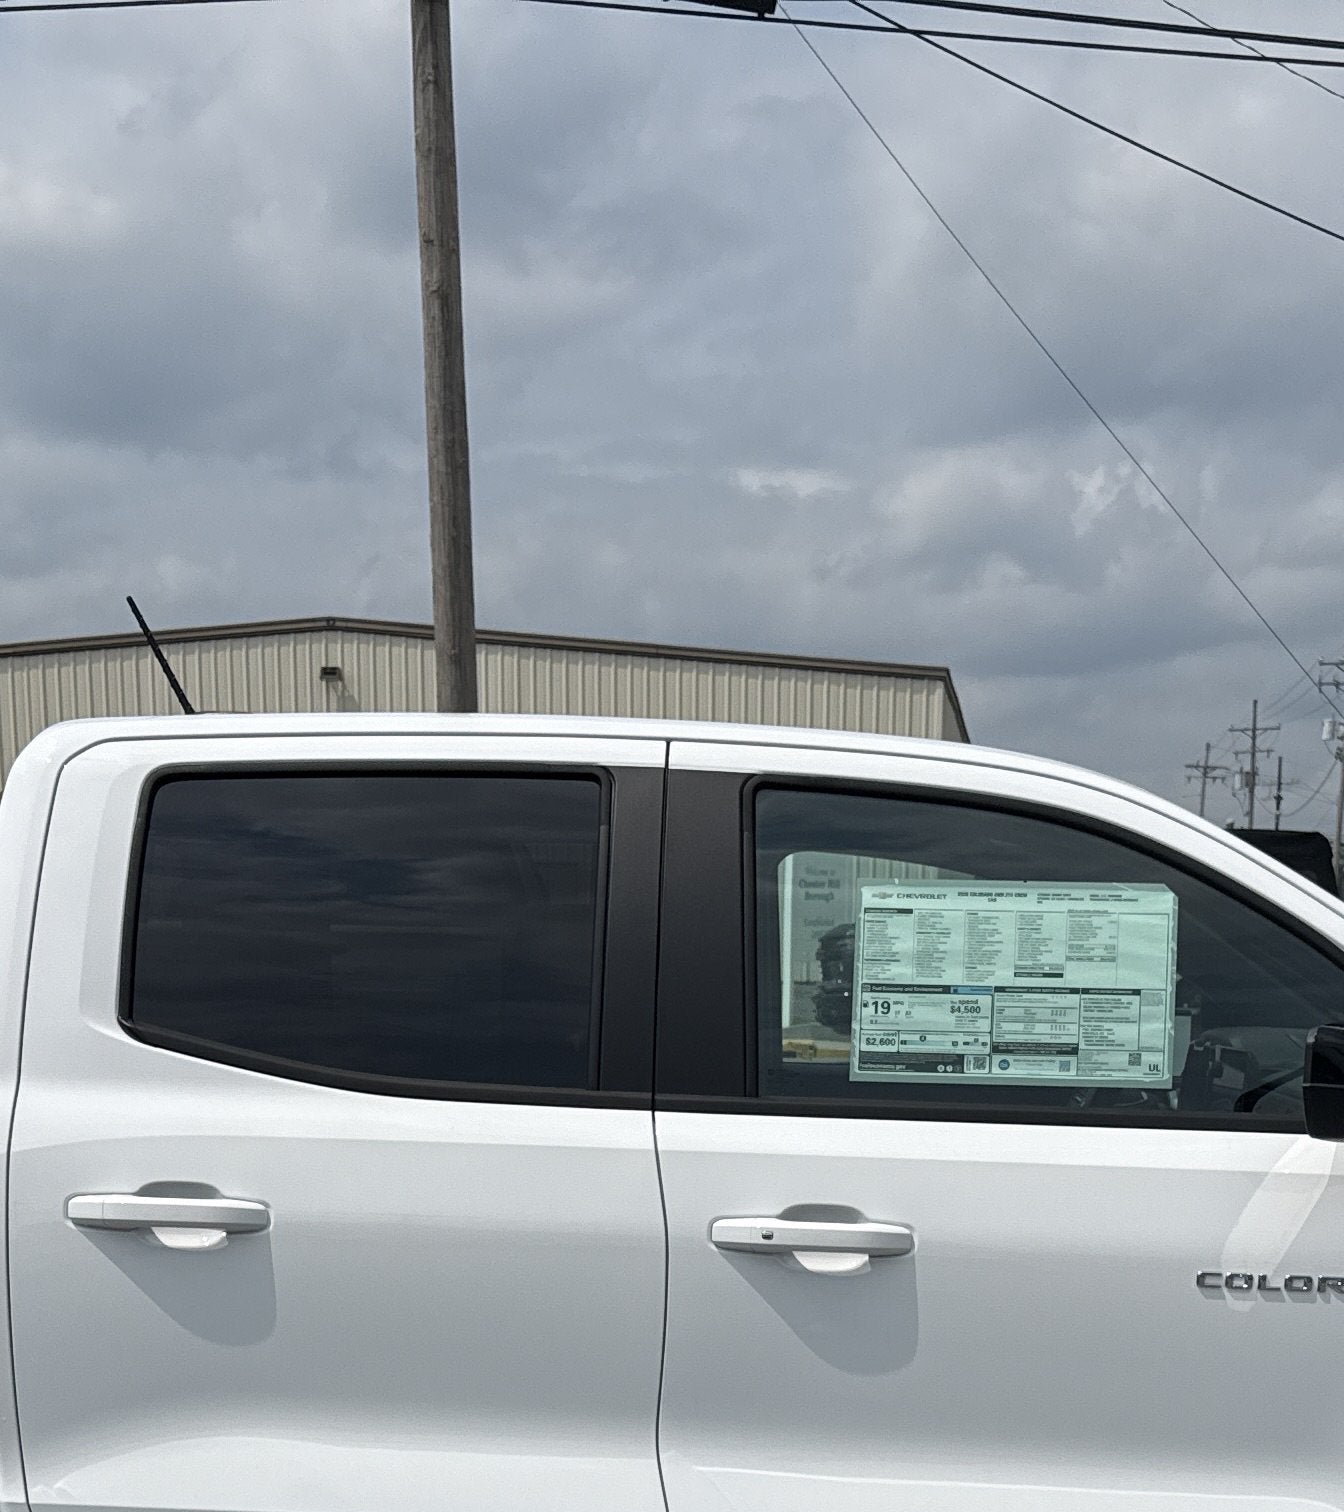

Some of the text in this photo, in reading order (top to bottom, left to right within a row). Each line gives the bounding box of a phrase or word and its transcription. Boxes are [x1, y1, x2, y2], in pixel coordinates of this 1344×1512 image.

[896, 892, 948, 900] CHEVROLET
[871, 1000, 891, 1014] 19
[949, 1005, 981, 1014] $4,500
[865, 1037, 896, 1047] $2,600
[1148, 1063, 1161, 1072] UL
